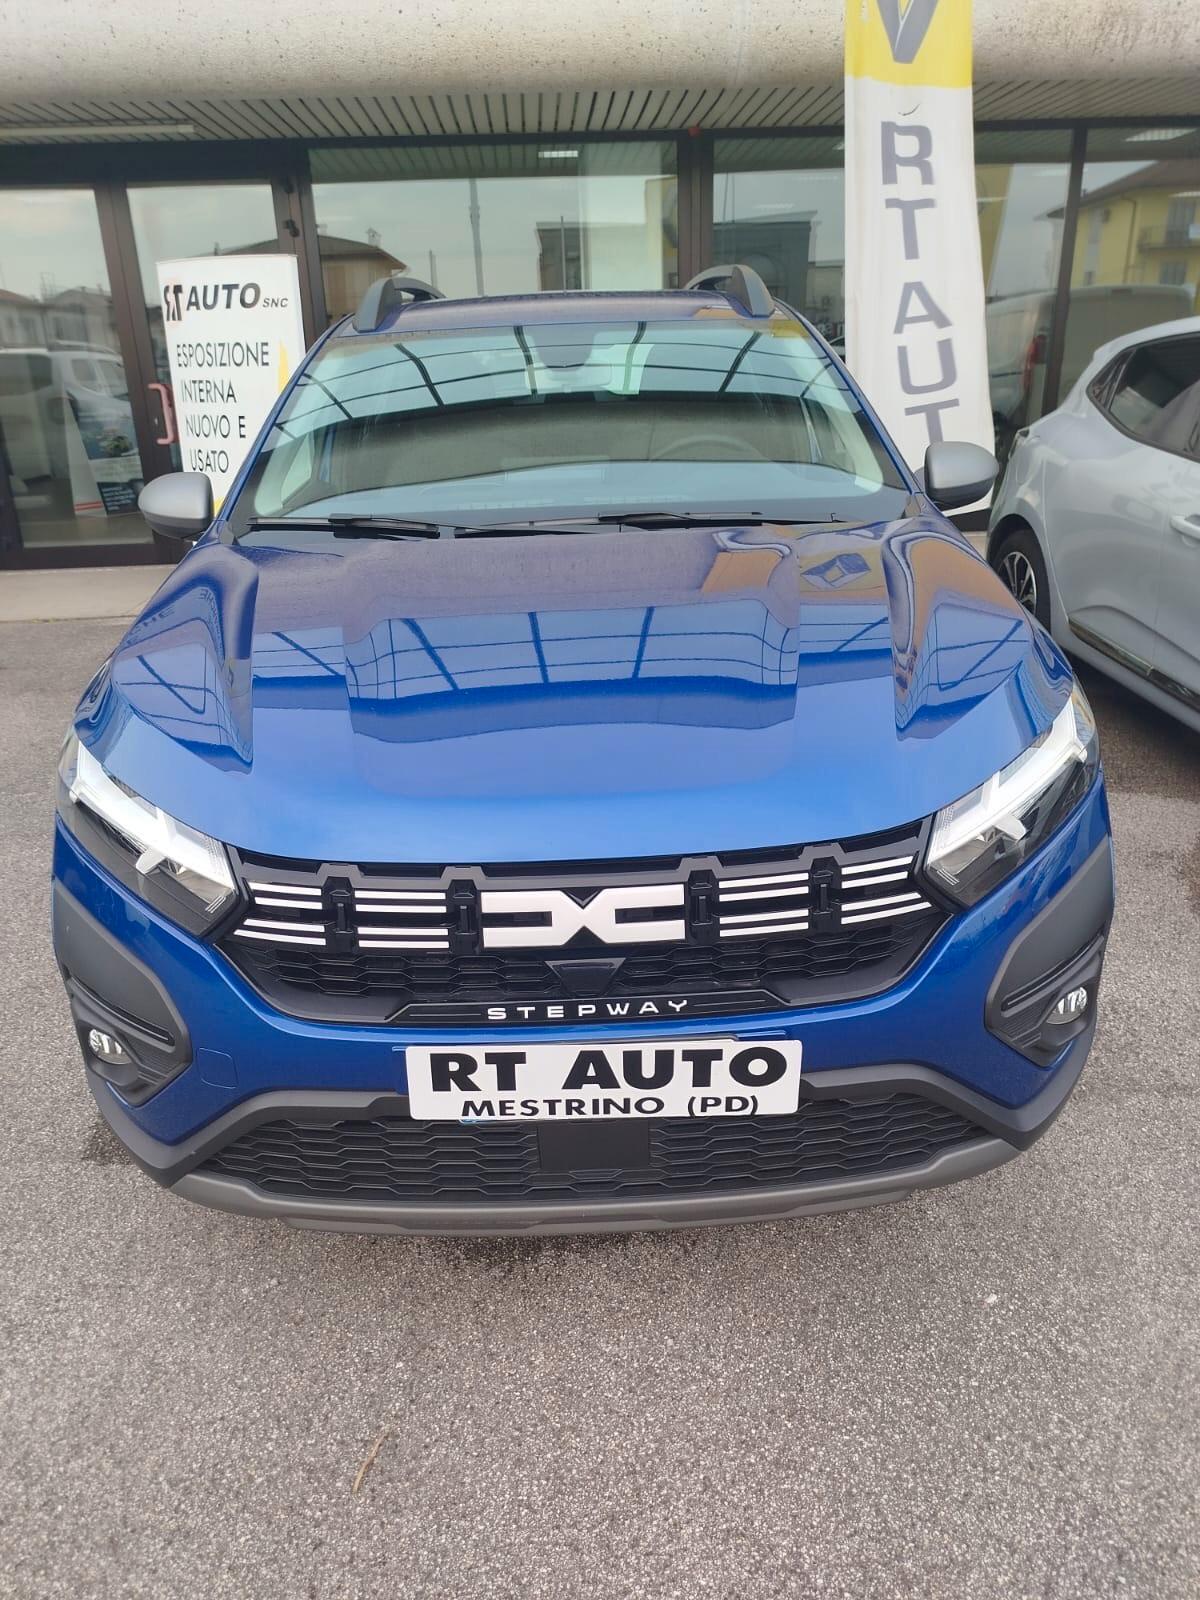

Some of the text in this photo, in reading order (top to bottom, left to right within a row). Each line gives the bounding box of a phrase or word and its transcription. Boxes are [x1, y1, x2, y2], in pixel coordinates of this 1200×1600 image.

[881, 121, 936, 260] RT
[186, 282, 261, 311] AUTO
[262, 298, 289, 308] SNC
[176, 342, 269, 368] ESPOSIZIONE
[181, 379, 236, 403] INTERNA
[185, 414, 246, 439] NUOVO E
[190, 448, 229, 473] USATO
[487, 1000, 688, 1020] STEPWAY
[430, 1046, 787, 1092] RT AUTO
[461, 1094, 759, 1118] MESTRINO (PD)
